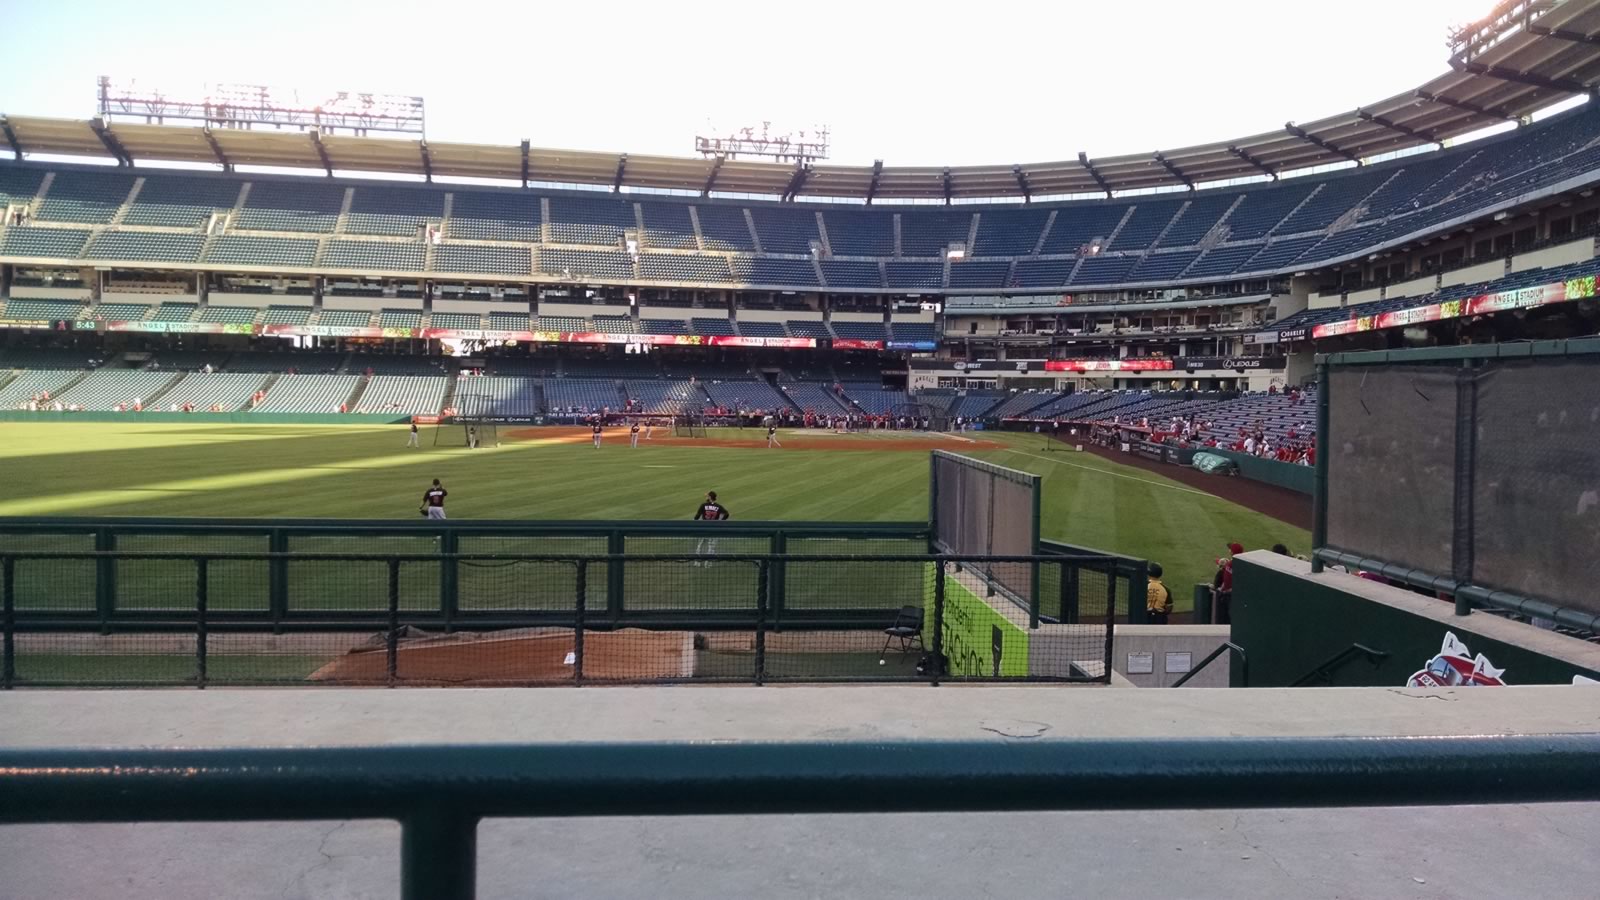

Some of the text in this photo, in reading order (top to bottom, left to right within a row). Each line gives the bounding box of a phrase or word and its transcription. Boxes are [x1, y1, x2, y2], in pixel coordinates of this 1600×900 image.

[1494, 294, 1514, 303] ANGEL
[1520, 288, 1544, 300] STADIUM
[915, 376, 934, 384] ANGELS
